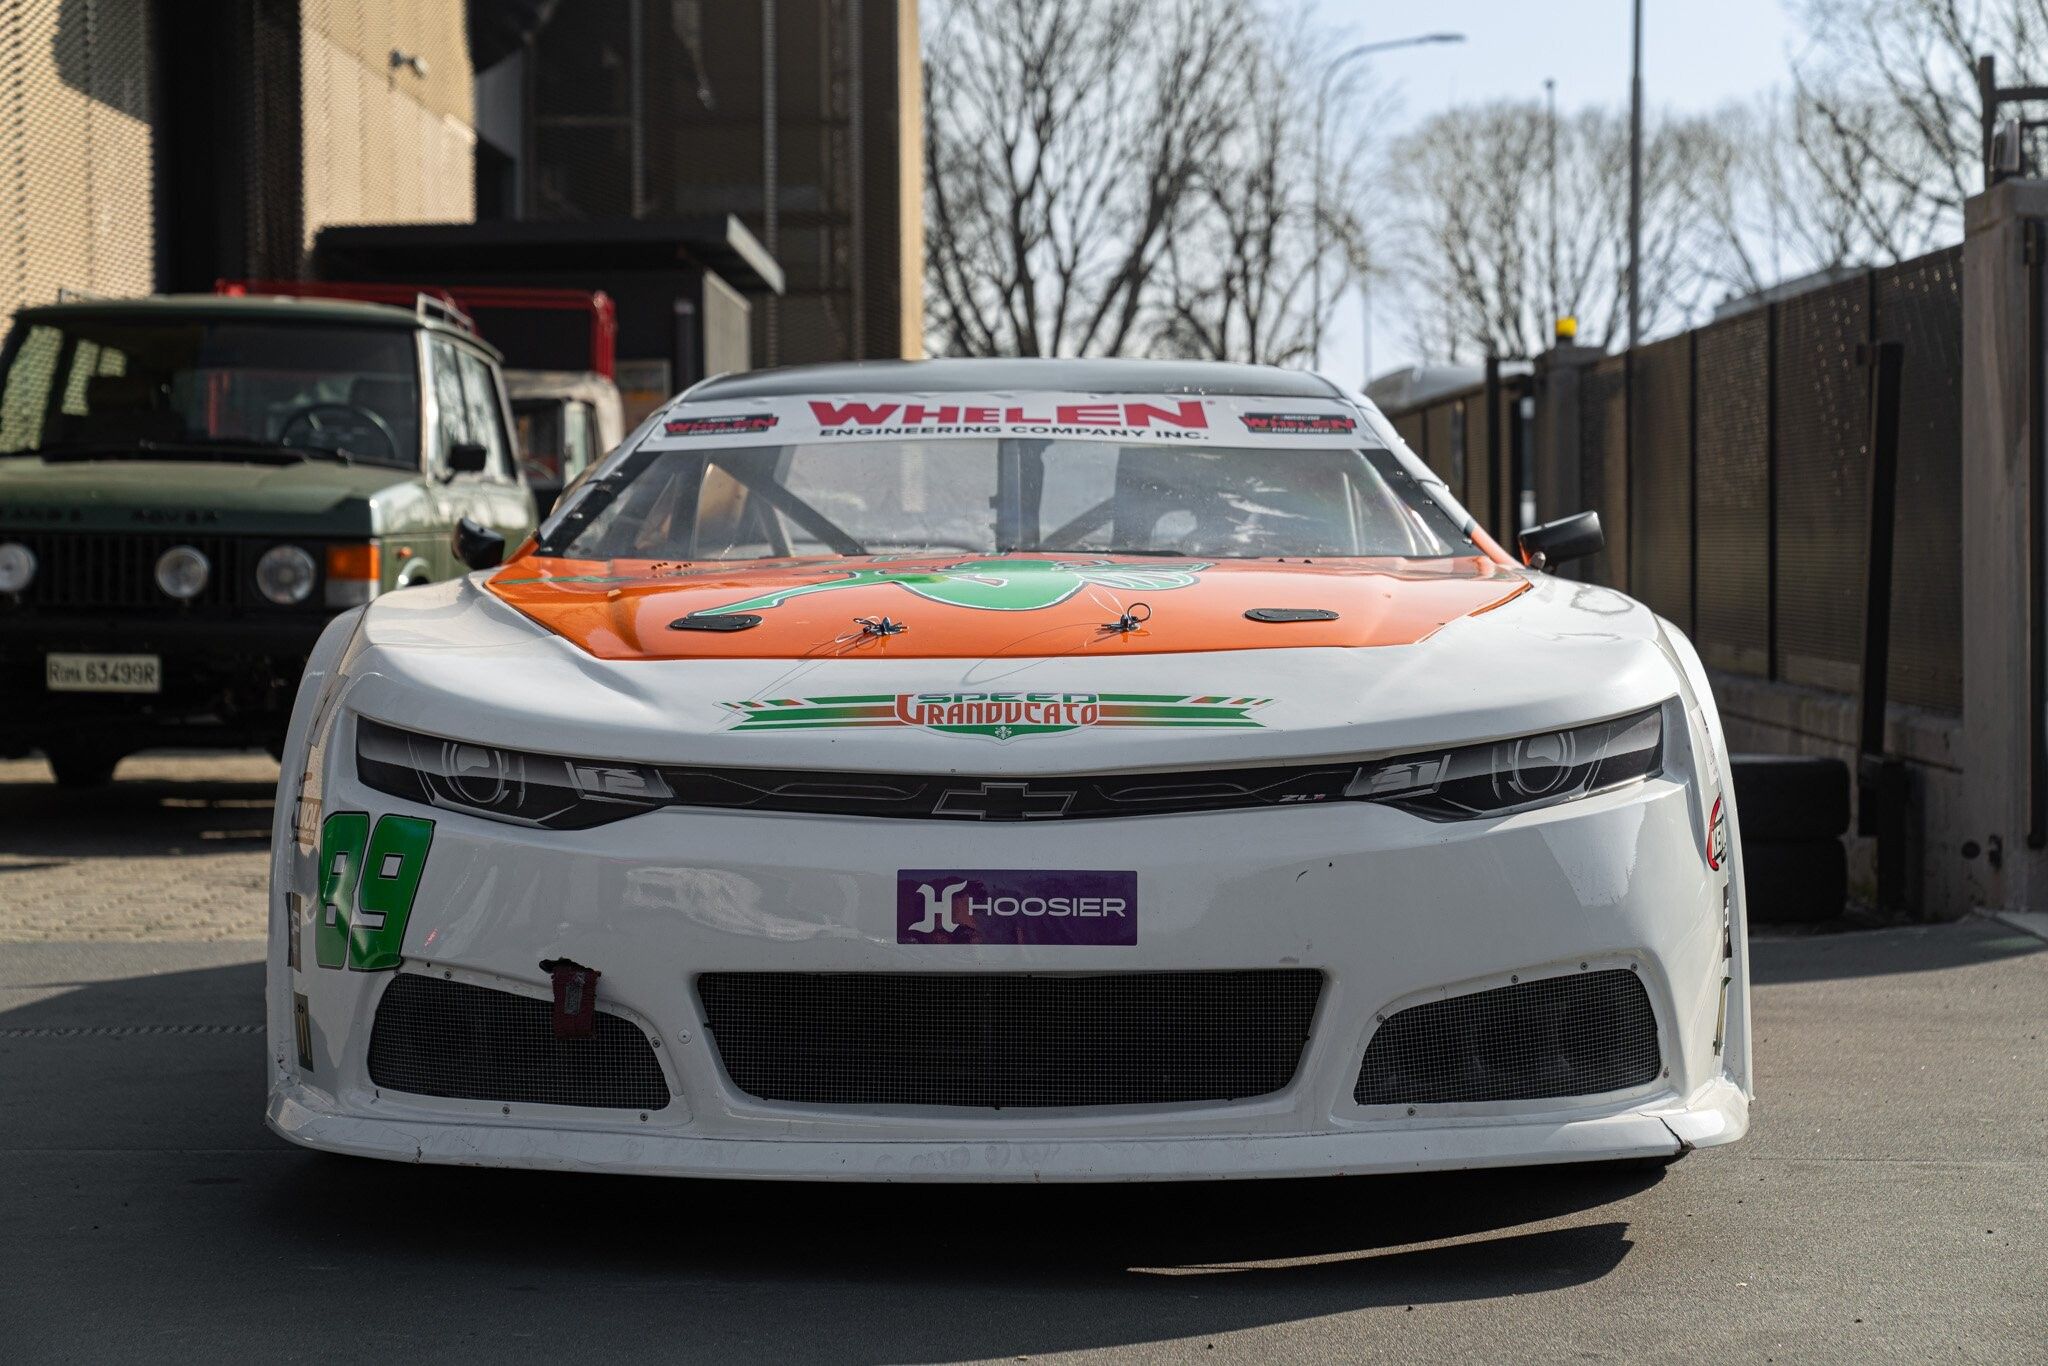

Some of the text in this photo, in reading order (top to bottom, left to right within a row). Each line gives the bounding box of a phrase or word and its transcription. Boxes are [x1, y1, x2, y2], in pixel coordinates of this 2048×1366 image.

[808, 401, 1208, 429] WHELEN
[1239, 415, 1357, 429] WHELEN
[664, 416, 779, 433] WHELEN
[819, 426, 1209, 440] ENGINEERING COMPANY INC.
[917, 692, 1097, 704] SPEED
[315, 811, 436, 973] 89
[968, 896, 1127, 918] HOOSIER
